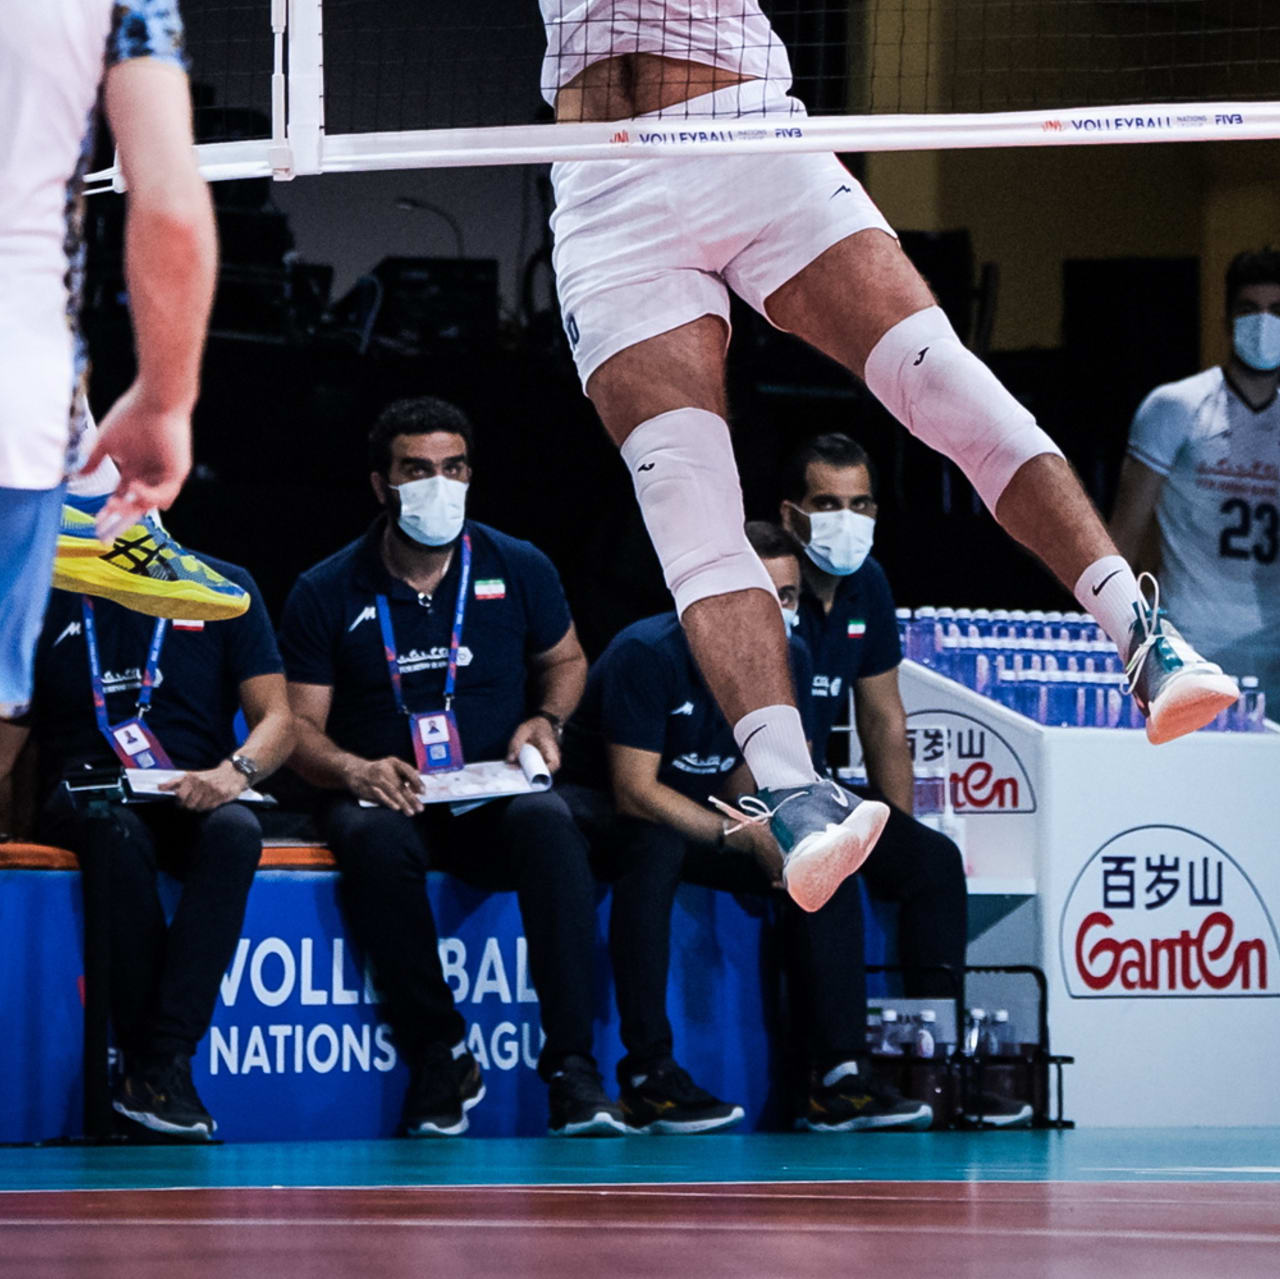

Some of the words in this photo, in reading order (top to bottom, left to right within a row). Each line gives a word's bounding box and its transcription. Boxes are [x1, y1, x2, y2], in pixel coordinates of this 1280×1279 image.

[775, 127, 802, 138] FIVB
[1215, 114, 1243, 125] FIVB
[1220, 497, 1279, 565] 23
[1101, 854, 1223, 910] 百岁山
[1075, 911, 1267, 990] Ganten
[210, 1024, 396, 1075] NATIONS
